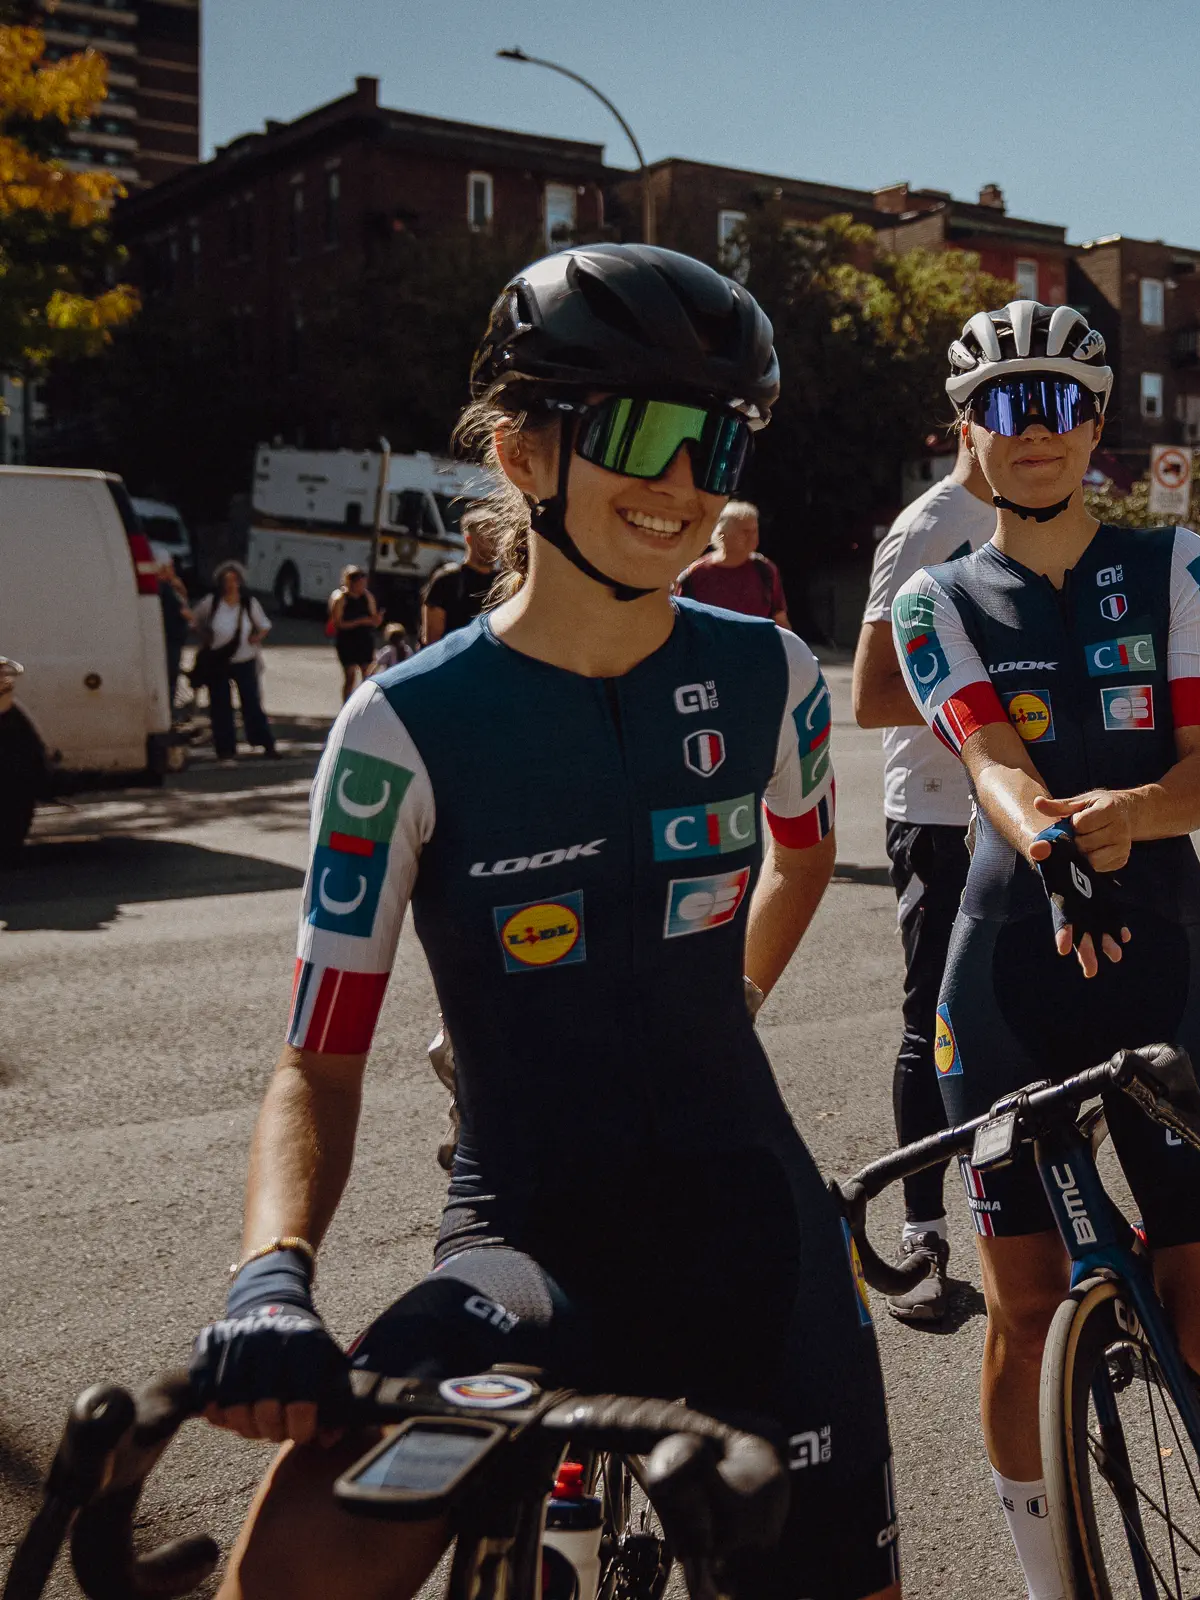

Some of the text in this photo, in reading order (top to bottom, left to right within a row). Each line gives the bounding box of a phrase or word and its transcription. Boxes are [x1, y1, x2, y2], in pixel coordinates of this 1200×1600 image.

[989, 660, 1060, 674] LOOK
[1094, 640, 1151, 669] CIC
[319, 768, 392, 916] CIC
[664, 804, 751, 851] CIC
[468, 838, 608, 877] LOOK
[1051, 1163, 1098, 1245] BMC
